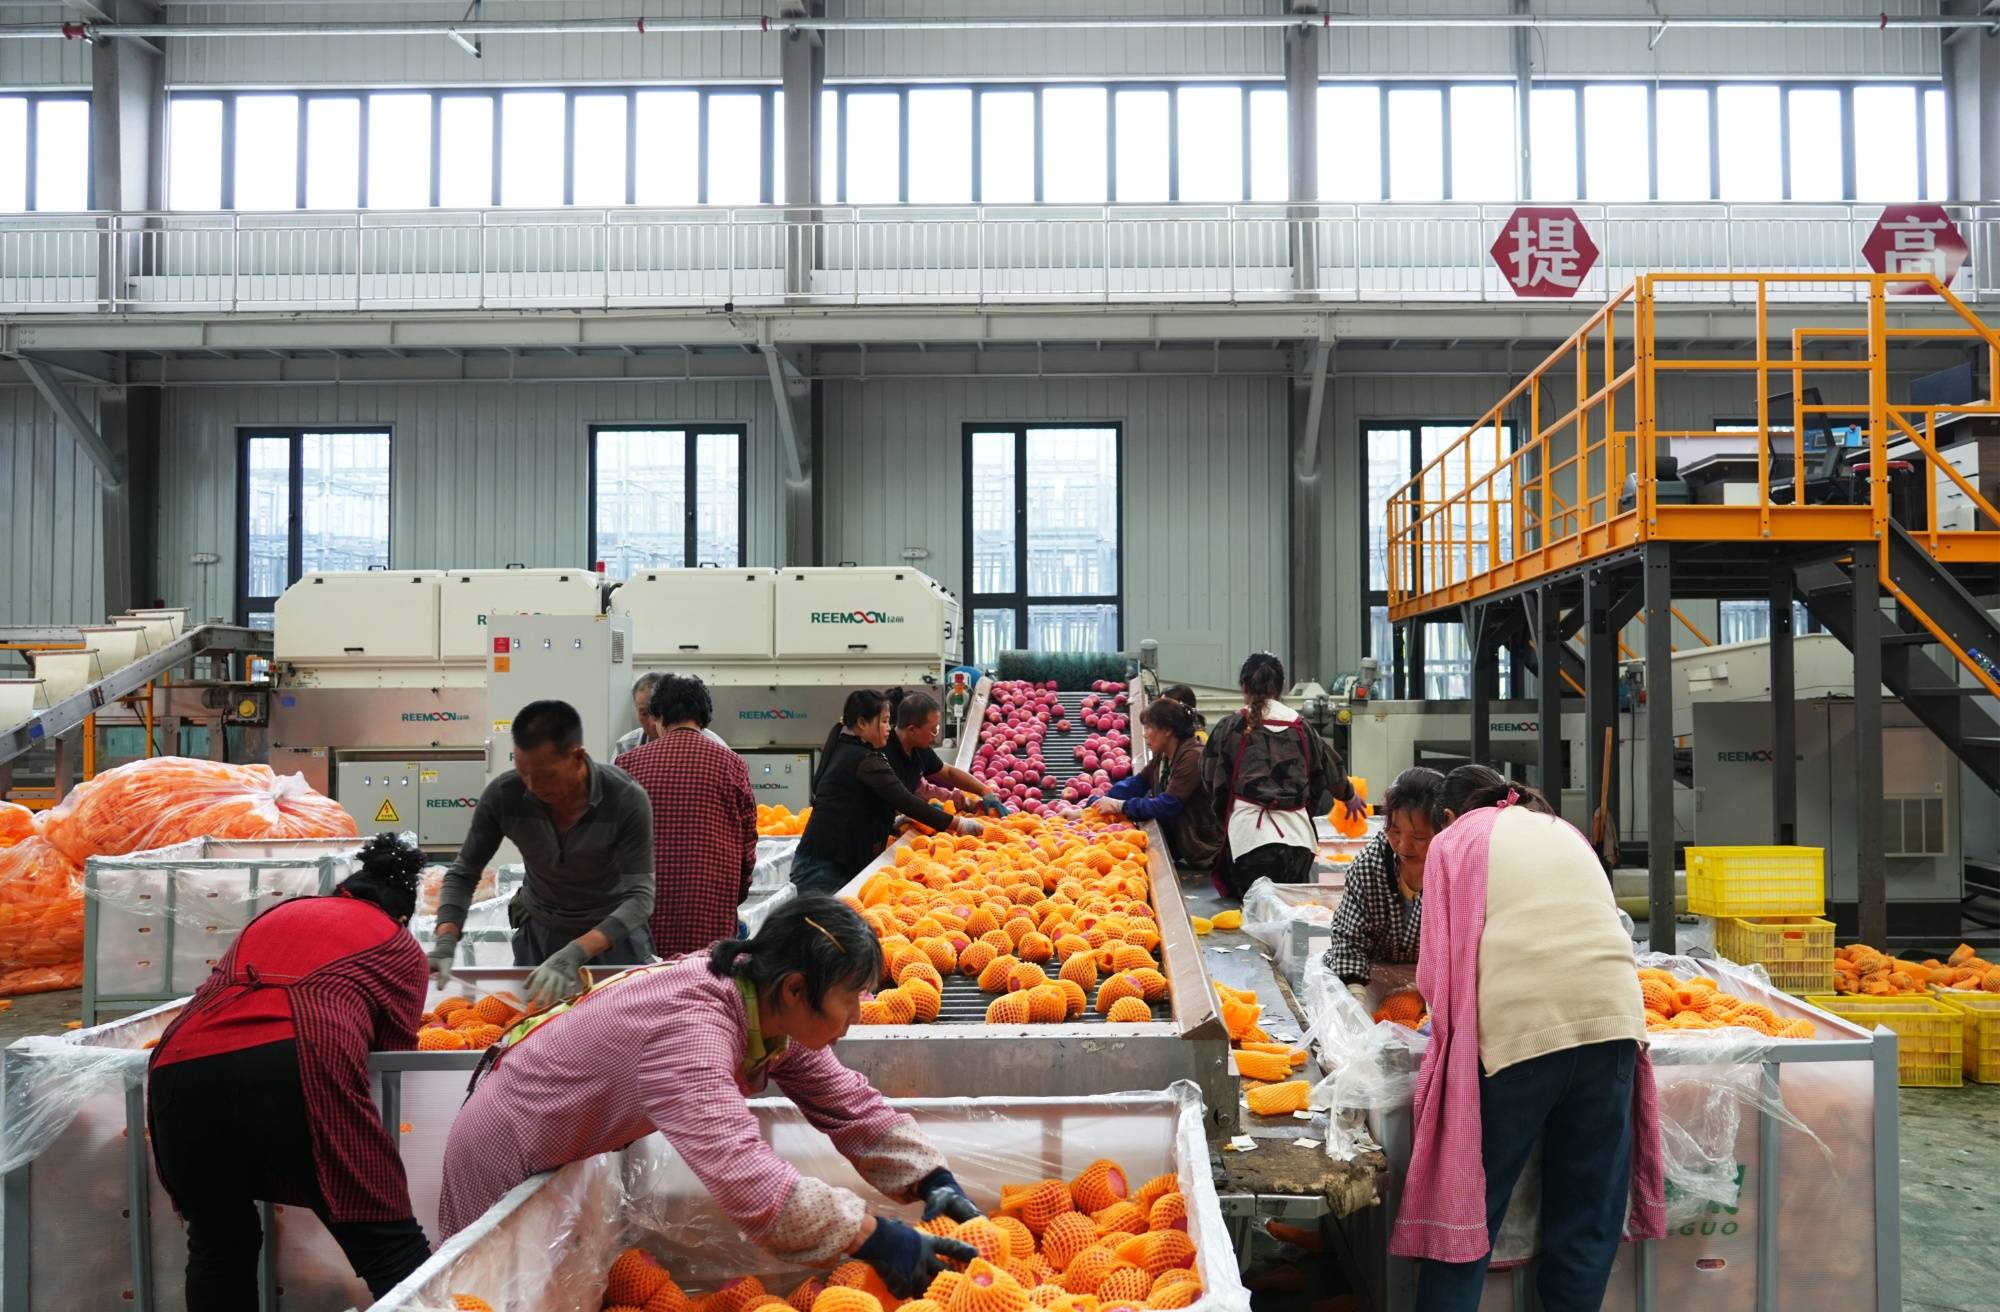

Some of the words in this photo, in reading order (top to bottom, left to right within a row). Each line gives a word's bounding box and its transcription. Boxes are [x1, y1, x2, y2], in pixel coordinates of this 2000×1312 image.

[1508, 217, 1582, 288] 提
[1880, 215, 1948, 288] 高
[811, 611, 886, 624] REEMOON
[401, 712, 457, 721] REEMOON
[739, 709, 794, 720] REEMOON
[426, 798, 480, 808] REEMOO
[1666, 1221, 1738, 1236] GUO
